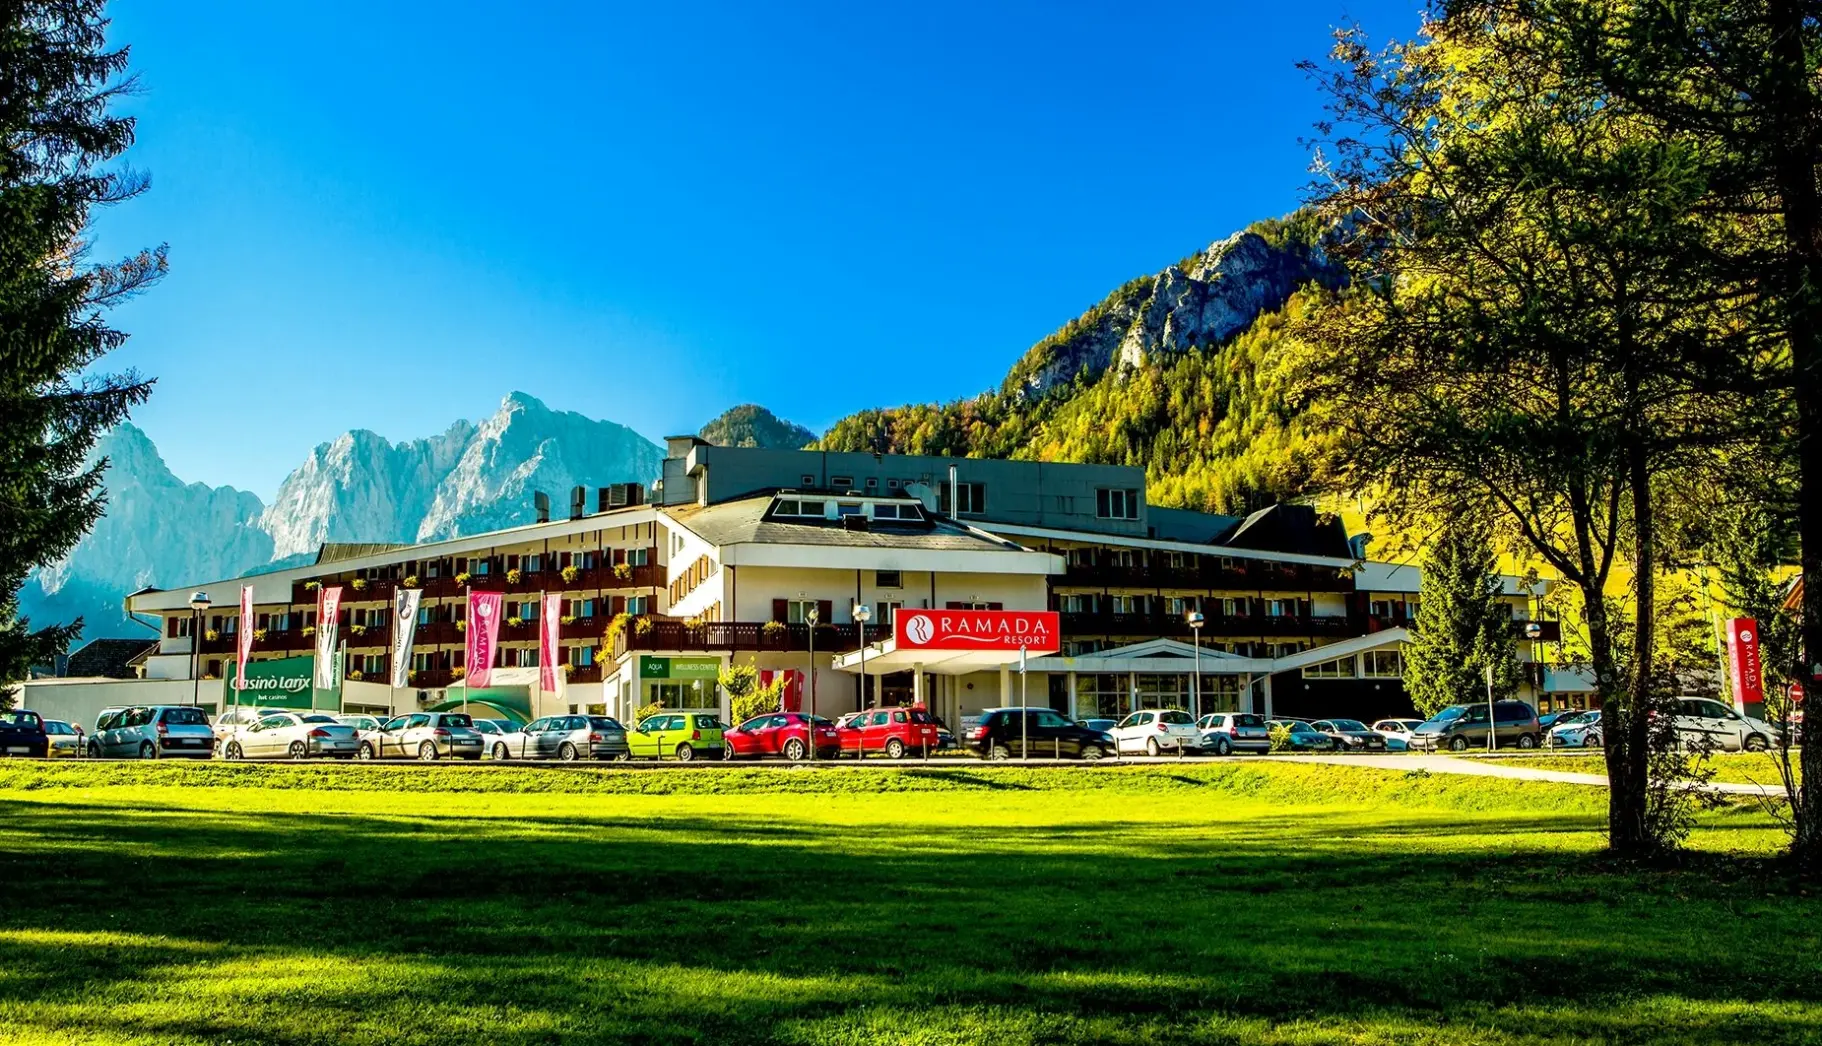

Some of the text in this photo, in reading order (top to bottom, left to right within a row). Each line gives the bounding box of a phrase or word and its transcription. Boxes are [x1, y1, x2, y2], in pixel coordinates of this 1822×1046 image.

[941, 616, 1045, 634] RAMADA
[1004, 635, 1047, 645] RESORT
[648, 663, 663, 671] AQUA
[675, 663, 717, 671] WELLNESS CENTER
[279, 674, 311, 692] Larix
